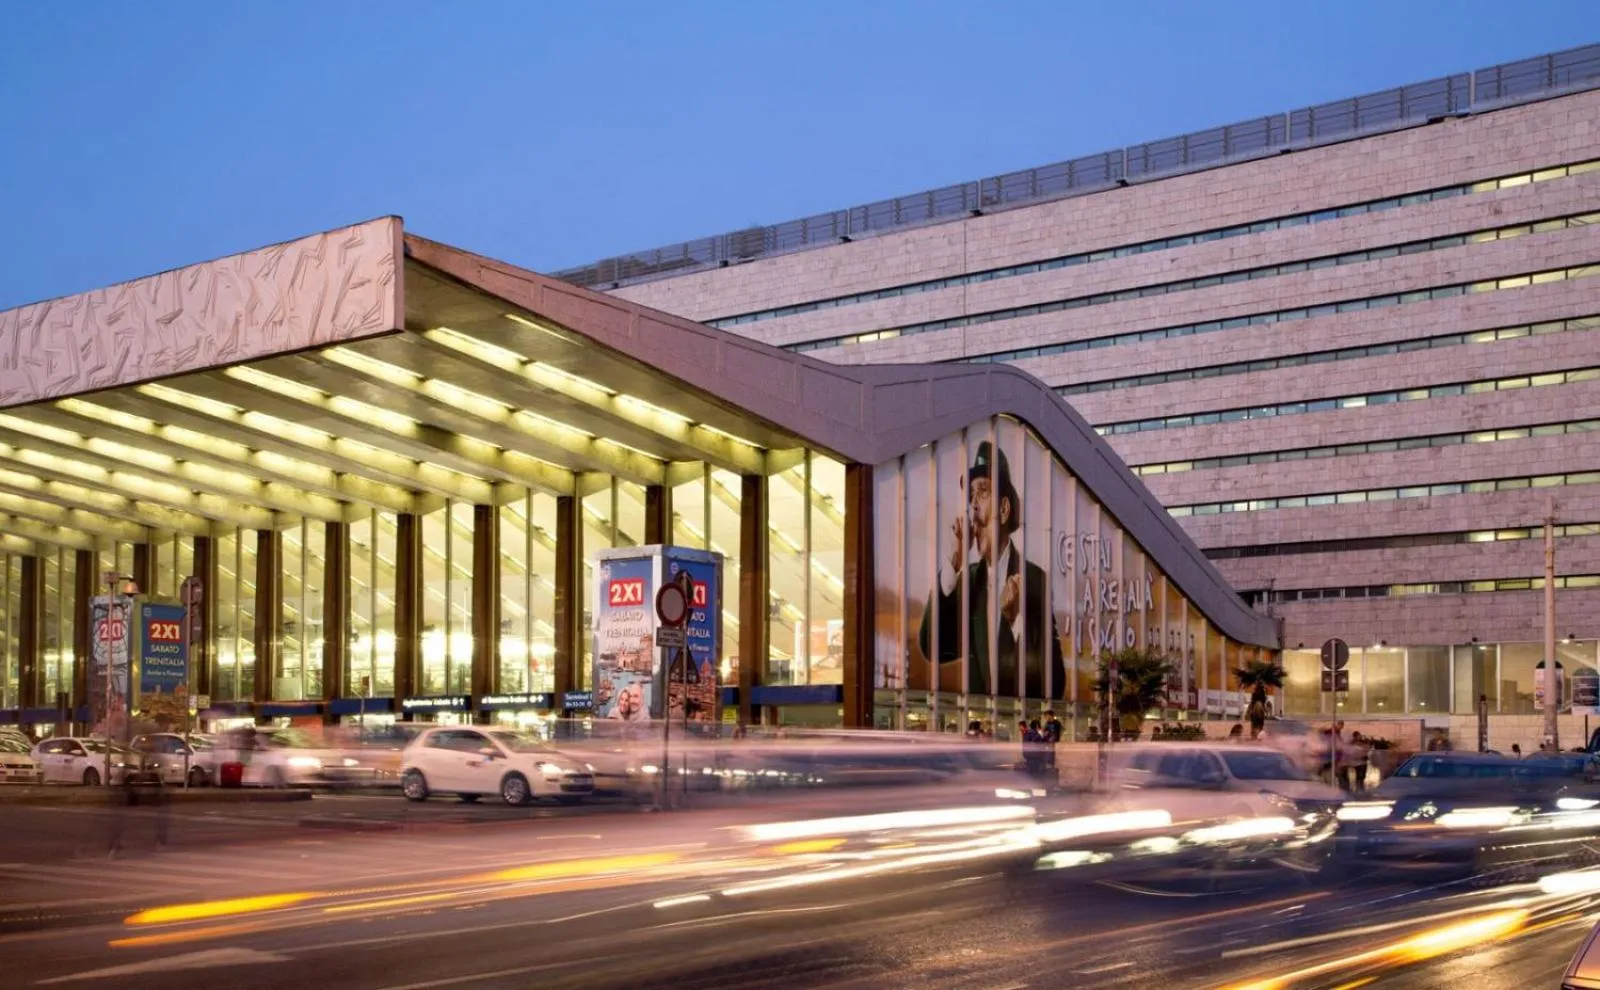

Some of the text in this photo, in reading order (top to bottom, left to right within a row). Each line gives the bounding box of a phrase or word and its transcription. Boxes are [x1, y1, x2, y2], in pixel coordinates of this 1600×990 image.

[610, 582, 642, 604] 2X1
[151, 622, 181, 640] 2X1
[151, 644, 180, 654] SABATO
[145, 656, 185, 667] TRENITALIA
